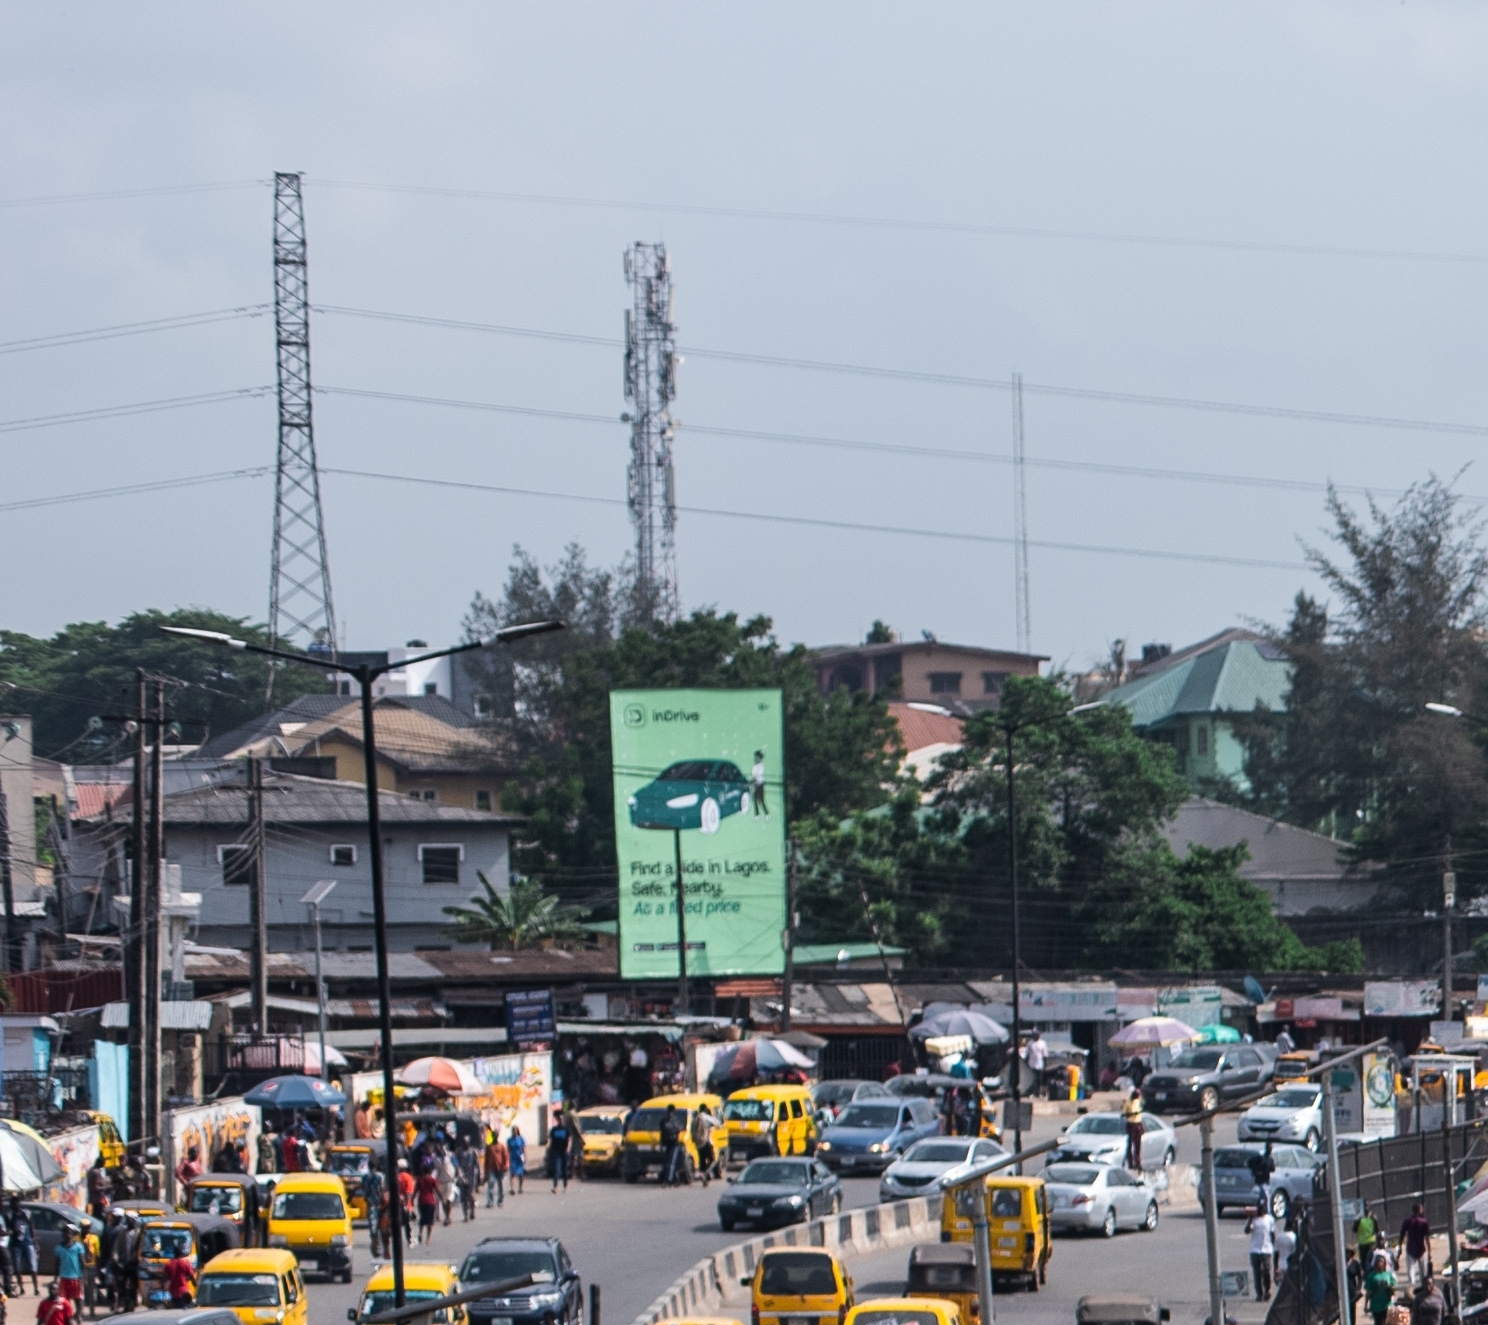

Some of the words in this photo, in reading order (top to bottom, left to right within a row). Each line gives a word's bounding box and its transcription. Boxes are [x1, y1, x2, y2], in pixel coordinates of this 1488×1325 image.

[652, 709, 701, 722] inDrive
[631, 860, 661, 875] Find
[708, 859, 720, 874] in
[725, 859, 772, 878] Lagos.
[705, 901, 741, 919] price
